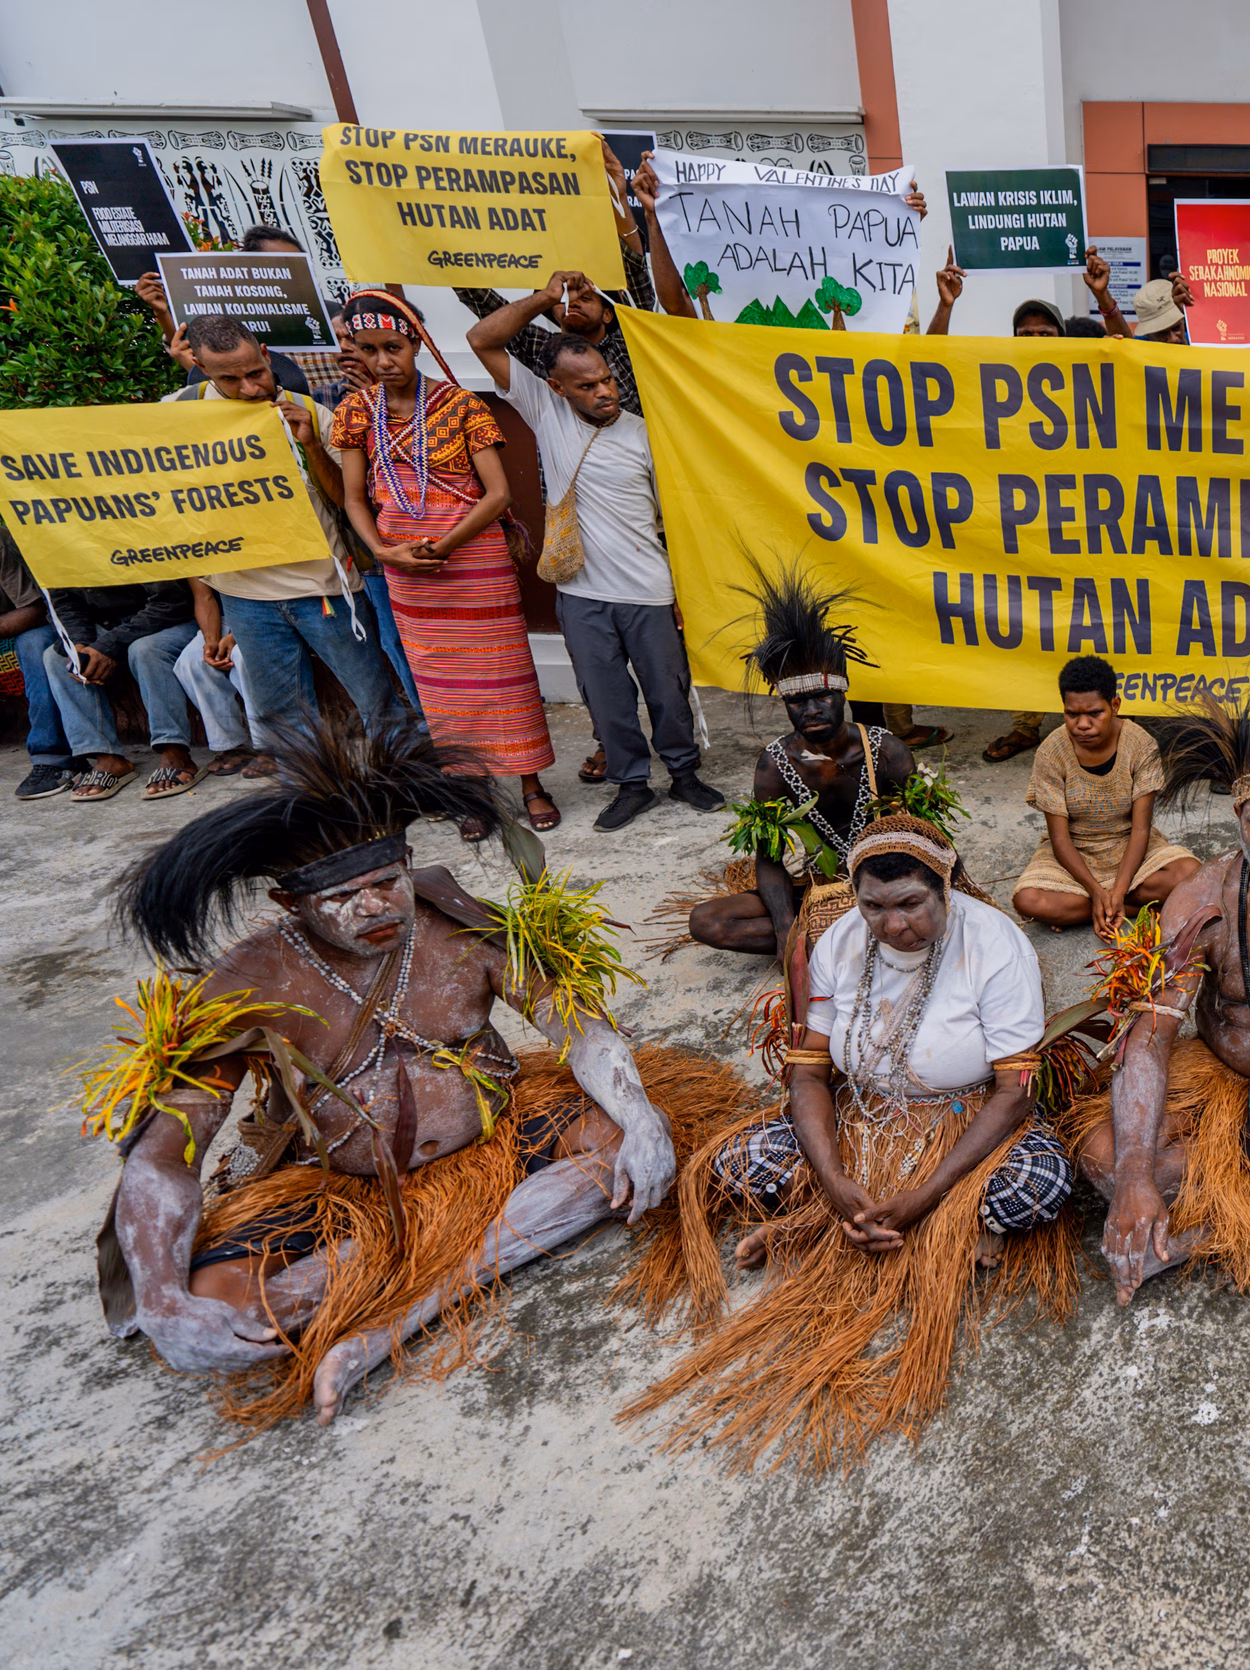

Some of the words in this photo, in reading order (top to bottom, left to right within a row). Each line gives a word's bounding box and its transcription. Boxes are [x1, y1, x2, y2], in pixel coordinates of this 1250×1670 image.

[340, 126, 396, 148] STOP
[404, 133, 450, 153] PSN
[459, 136, 577, 163] MERAUKE,
[80, 181, 99, 194] PSN
[345, 160, 408, 188] STOP
[415, 165, 581, 195] PERAMPASAN
[675, 160, 726, 183] HAPPY
[754, 165, 861, 189] VALENTINE'S
[870, 172, 899, 193] DAY
[953, 191, 995, 207] LAWAN
[998, 190, 1037, 206] KRISIS
[1040, 190, 1078, 206] IKLIM,
[91, 207, 113, 220] FOOD
[110, 207, 137, 220] ESTATE
[397, 201, 481, 230] HUTAN
[488, 206, 547, 232] ADAT
[669, 192, 801, 238] TANAH
[828, 203, 918, 249] PAPUA
[968, 214, 1025, 229] LINDUNGI
[1027, 213, 1067, 228] HUTAN
[103, 233, 149, 246] MELANGGAR
[146, 232, 170, 246] HAM
[1000, 236, 1040, 251] PAPUA
[427, 250, 542, 269] GREENPEACE
[717, 242, 828, 280] ADALAH
[852, 252, 915, 295] KITA
[1206, 249, 1240, 264] PROYEK
[180, 267, 217, 280] TANAH
[219, 267, 249, 280] ADAT
[251, 267, 292, 280] BUKAN
[194, 285, 233, 297] TANAH
[234, 285, 288, 299] KOSONG,
[1203, 281, 1248, 297] NASIONAL
[183, 303, 224, 315] LAWAN
[226, 303, 311, 315] KOLONIALISME
[773, 351, 955, 448] STOP
[979, 362, 1118, 451] PSN
[1, 452, 82, 481] SAVE
[87, 434, 267, 477] INDIGENOUS
[169, 475, 295, 514] FORESTS
[804, 461, 975, 551] STOP
[110, 536, 245, 567] GREENPEACE
[932, 570, 1152, 655] HUTAN
